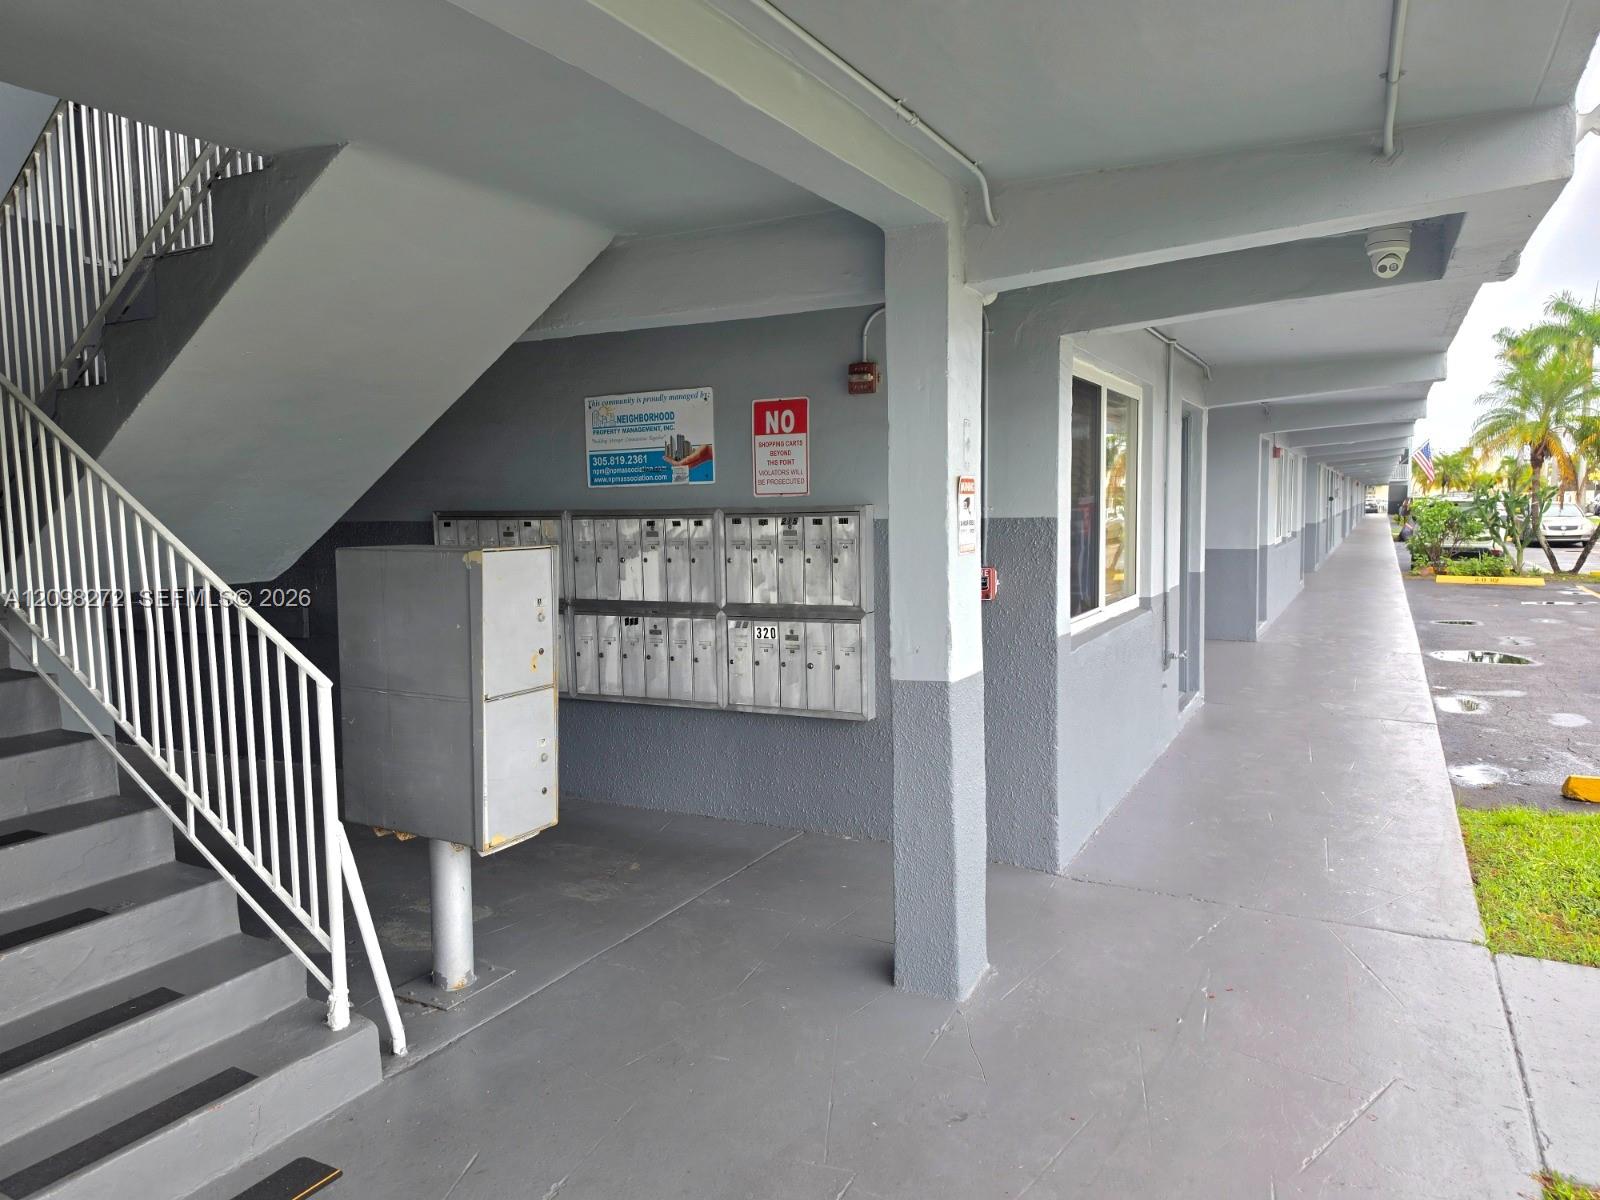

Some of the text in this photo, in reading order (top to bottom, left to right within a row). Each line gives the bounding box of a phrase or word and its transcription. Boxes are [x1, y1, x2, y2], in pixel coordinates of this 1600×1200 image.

[588, 398, 600, 408] This
[601, 396, 635, 407] community
[636, 395, 642, 403] is
[642, 393, 667, 405] proudly
[668, 391, 698, 402] managed
[616, 411, 675, 423] NEIGHBORHOOD
[765, 409, 795, 434] NO
[621, 424, 663, 434] MANAGEMENT,
[769, 449, 792, 457] BEYOND
[592, 454, 648, 466] 305.819.2361
[779, 458, 795, 466] POINT
[756, 627, 776, 639] 320
